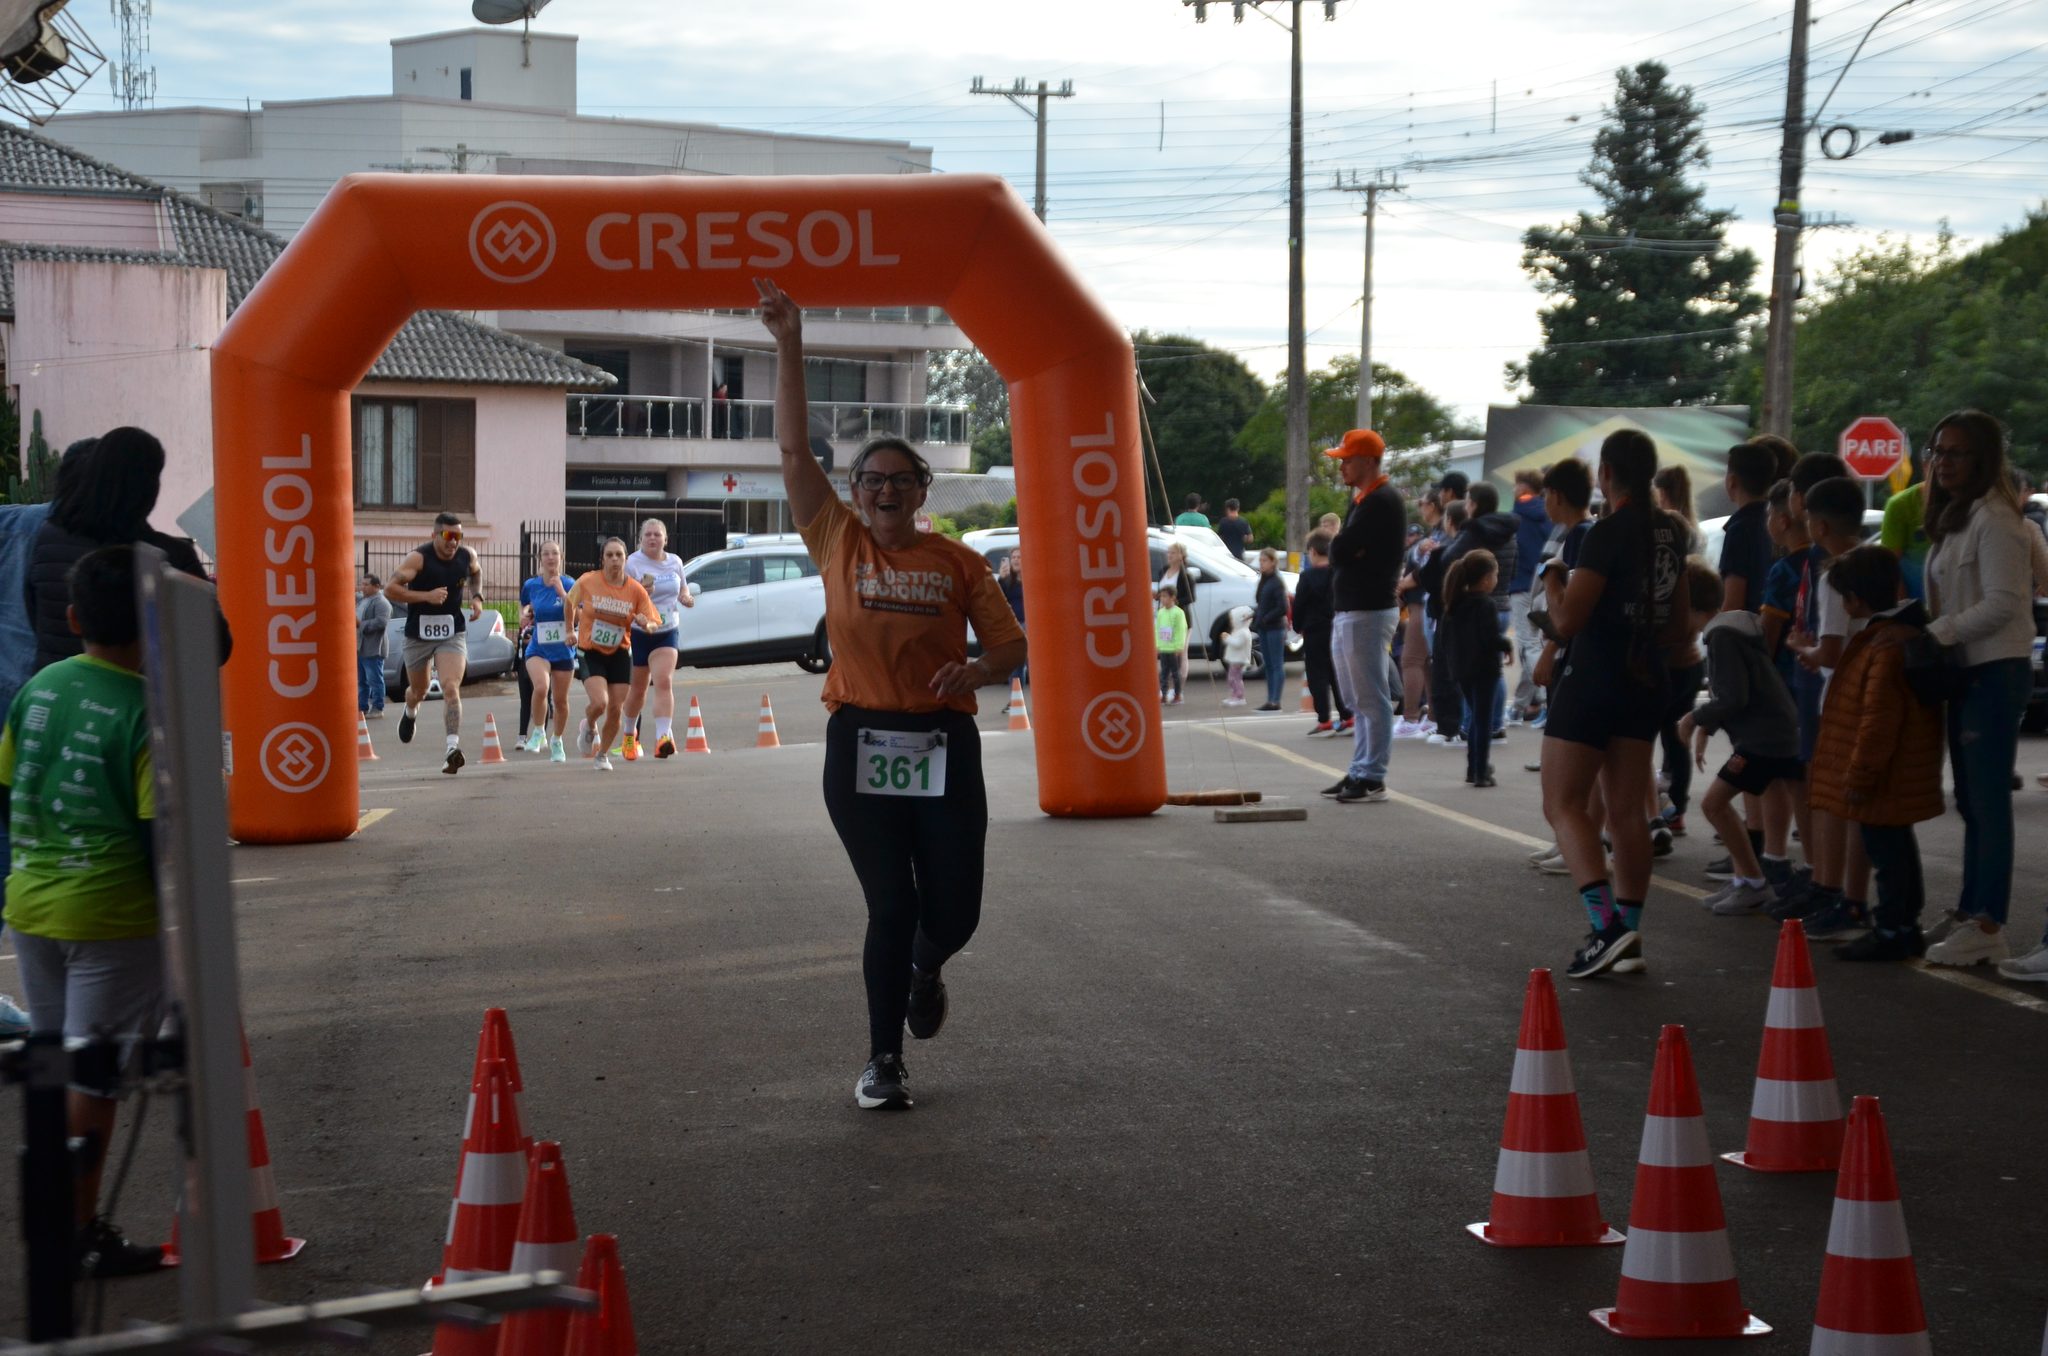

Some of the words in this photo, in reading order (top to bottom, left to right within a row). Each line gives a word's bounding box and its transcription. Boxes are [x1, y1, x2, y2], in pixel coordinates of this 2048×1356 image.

[586, 209, 900, 270] CRESOL
[1846, 439, 1900, 456] PARE
[1070, 411, 1131, 668] CRESOL
[262, 433, 319, 698] CRESOL
[876, 565, 953, 592] ÚSTICA
[854, 579, 949, 603] REGIONAL
[424, 624, 450, 637] 689
[545, 629, 560, 641] 34
[594, 629, 618, 645] 281
[868, 754, 929, 791] 361
[1585, 939, 1605, 961] FILA
